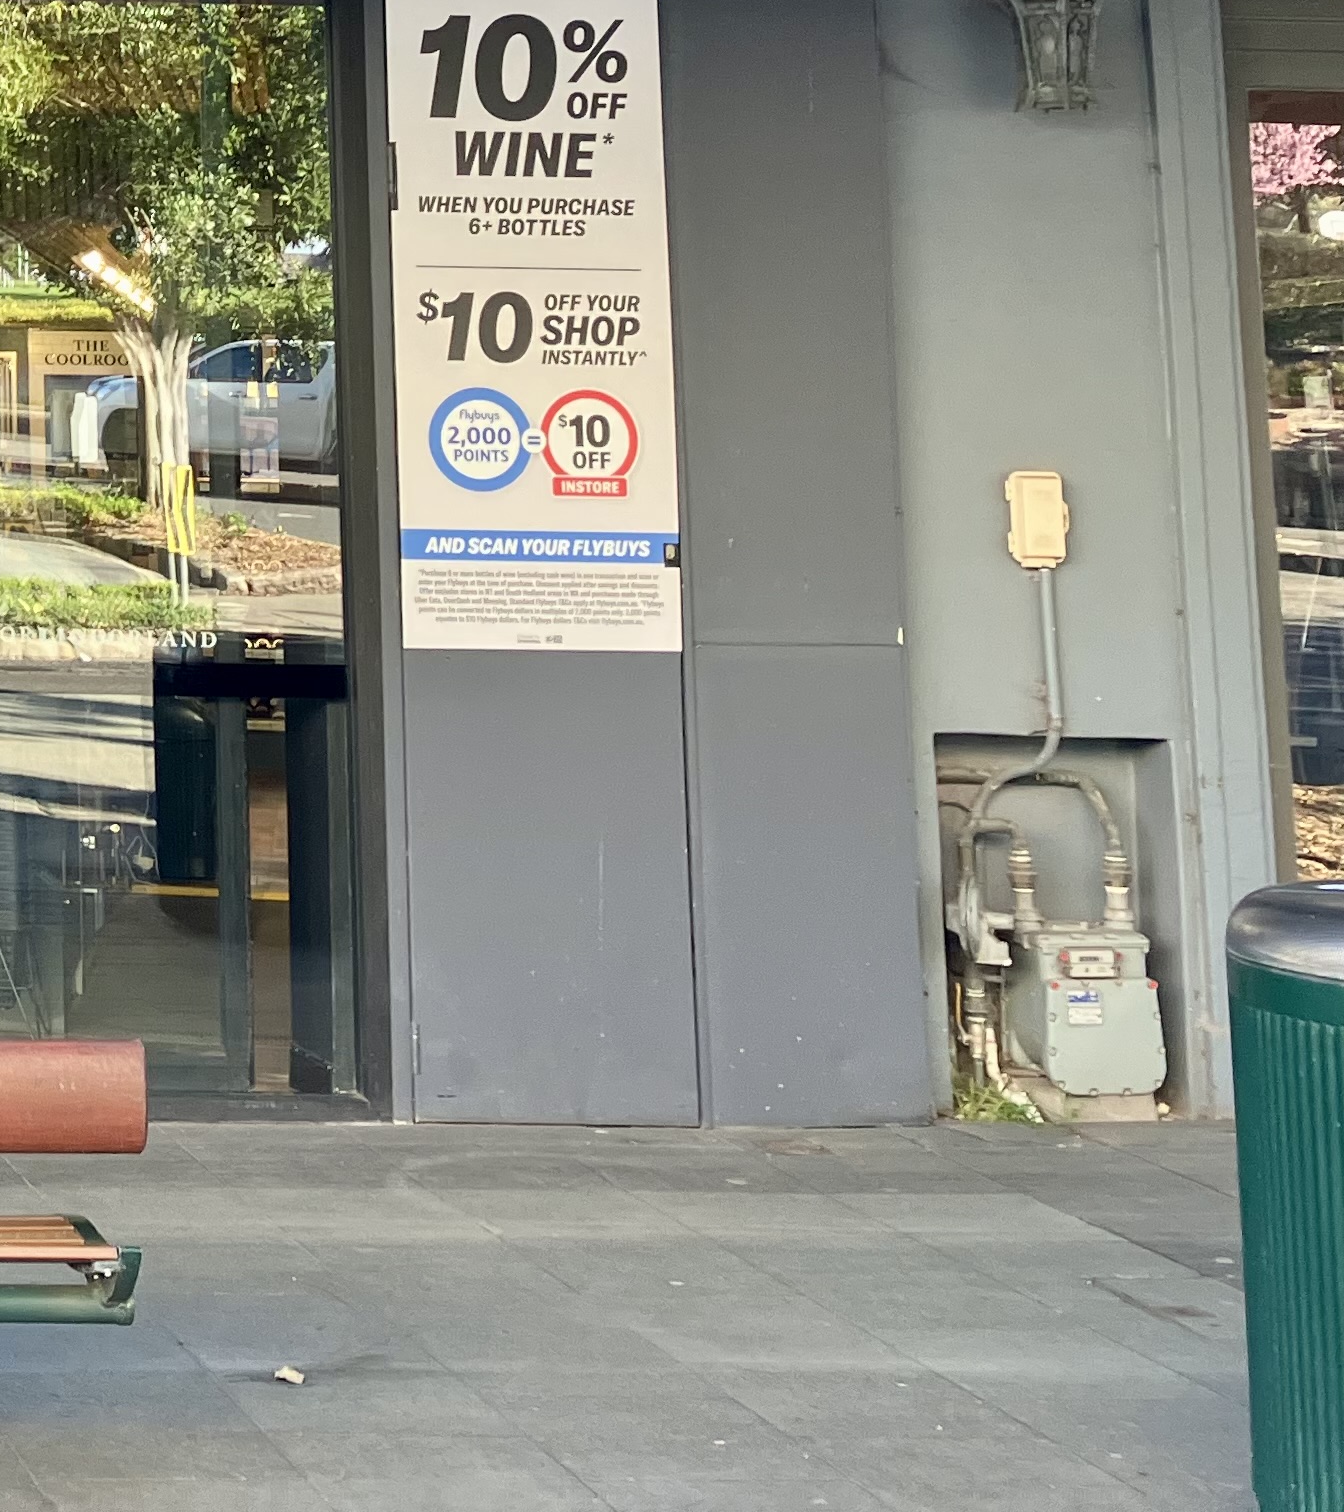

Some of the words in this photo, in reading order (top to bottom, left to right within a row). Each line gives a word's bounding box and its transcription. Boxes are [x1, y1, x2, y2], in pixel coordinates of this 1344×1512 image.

[420, 14, 628, 122] 10%
[567, 92, 628, 120] OFF
[418, 196, 477, 213] WHEN
[483, 197, 523, 214] YOU
[527, 198, 635, 216] PURCHASE
[468, 218, 492, 235] 6+
[497, 219, 586, 236] BOTTLES
[544, 294, 582, 311] OFF
[586, 295, 640, 312] YOUR
[416, 288, 533, 364] $10
[540, 315, 640, 346] SHOP
[73, 340, 109, 352] THE
[459, 409, 500, 423] flybuys
[447, 427, 511, 448] 2,000
[558, 414, 611, 448] $10
[454, 449, 509, 463] POINTS
[573, 451, 611, 470] OFF
[561, 481, 620, 494] INSTORE
[425, 536, 465, 554] AND
[468, 537, 518, 555] SCAN
[522, 538, 570, 556] YOUR
[573, 540, 651, 557] FLYBUYS
